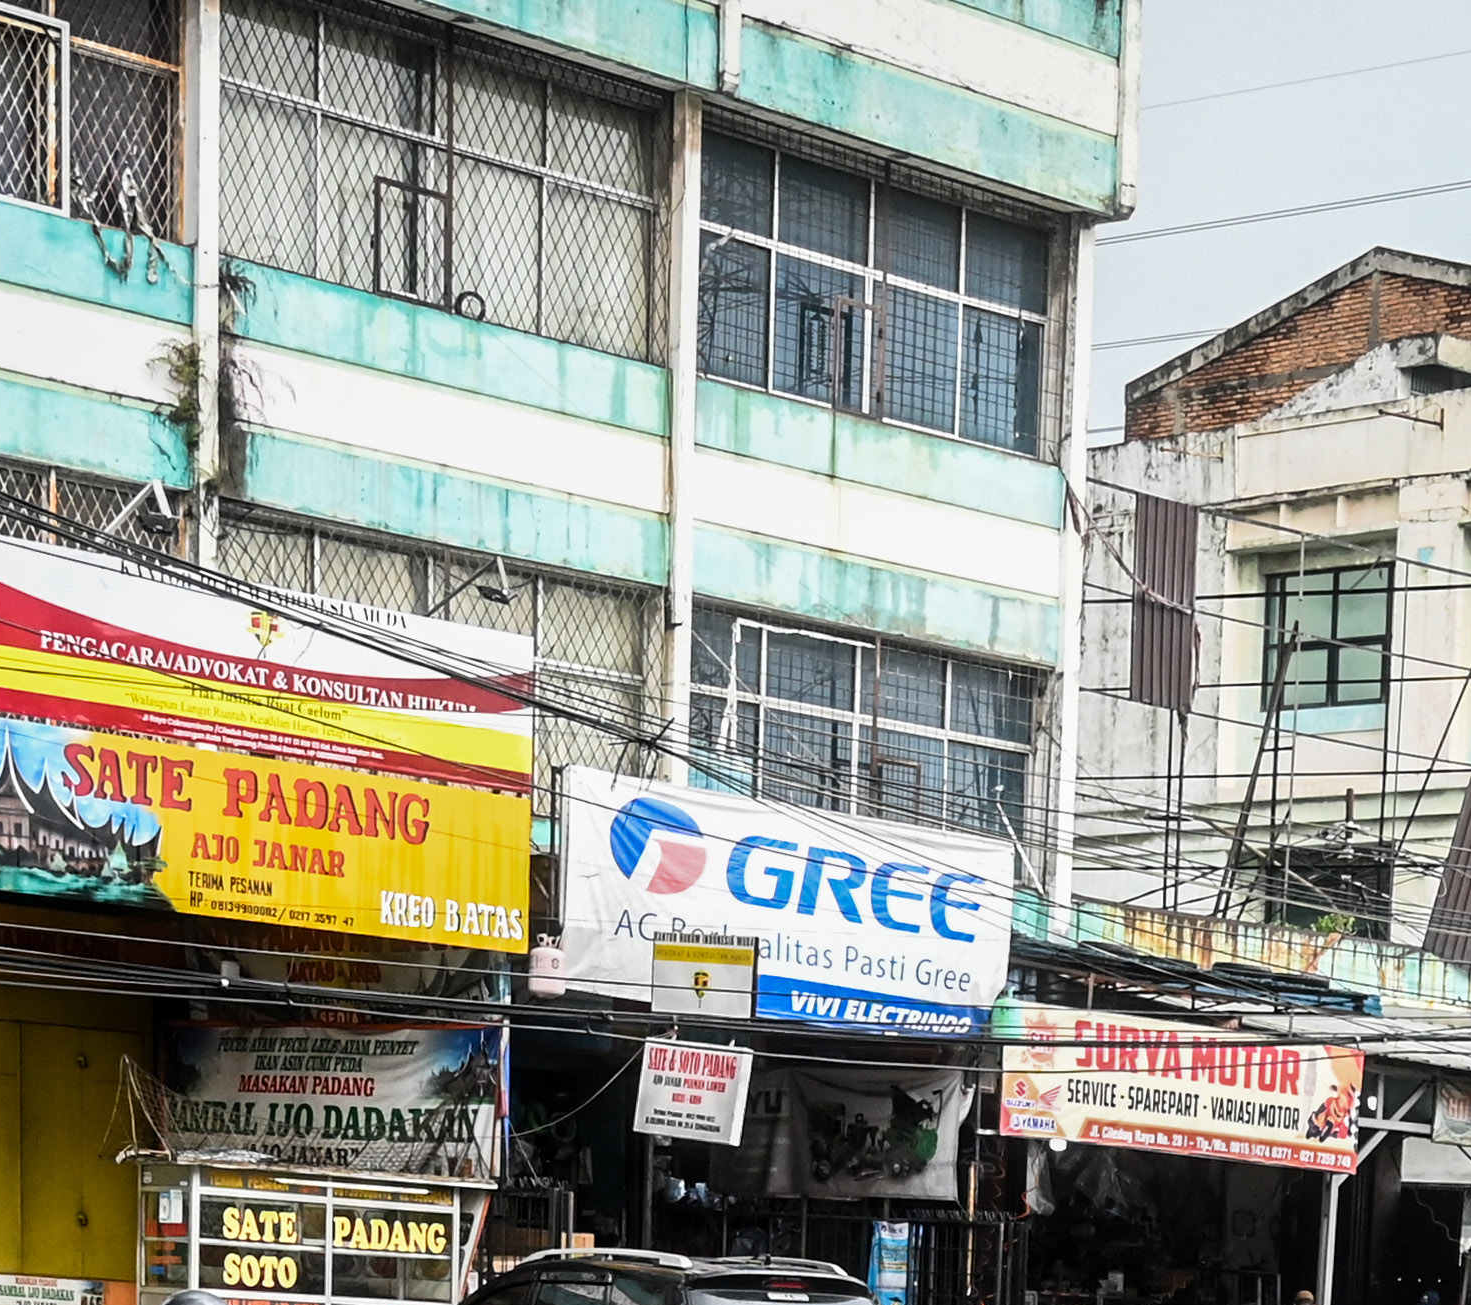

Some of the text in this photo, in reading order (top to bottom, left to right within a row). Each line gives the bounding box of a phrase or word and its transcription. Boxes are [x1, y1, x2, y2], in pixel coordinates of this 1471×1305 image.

[39, 630, 269, 686] PENGACARA/ADVOKAT
[272, 670, 289, 690] &
[292, 673, 403, 709] KONSULTAN
[62, 743, 430, 846] SATE PADANG
[191, 832, 345, 878] AJO JANAR
[188, 870, 273, 897] TERIMA PESANAN
[726, 835, 985, 943] GREE
[380, 890, 435, 930] KREO
[844, 945, 905, 982] Pasti
[915, 960, 971, 992] Gree
[789, 990, 972, 1034] VIVI ELECTRINDO
[254, 1055, 363, 1072] IKAN ASIN CUMI PEDA
[648, 1047, 737, 1080] SATE & SOTO PADANG
[1074, 1019, 1301, 1097] SURYA MOTOR
[238, 1074, 375, 1097] MASAKAN PADANG
[1006, 1099, 1035, 1108] SUZUKI
[1067, 1078, 1300, 1132] SERVICE SPAREPART VARIASI MOTOR
[268, 1103, 314, 1138] IJO
[322, 1105, 479, 1144] DADAKAN
[1022, 1117, 1056, 1131] YAMAHA
[222, 1207, 447, 1254] SATE PADANG
[222, 1253, 298, 1289] SOTO
